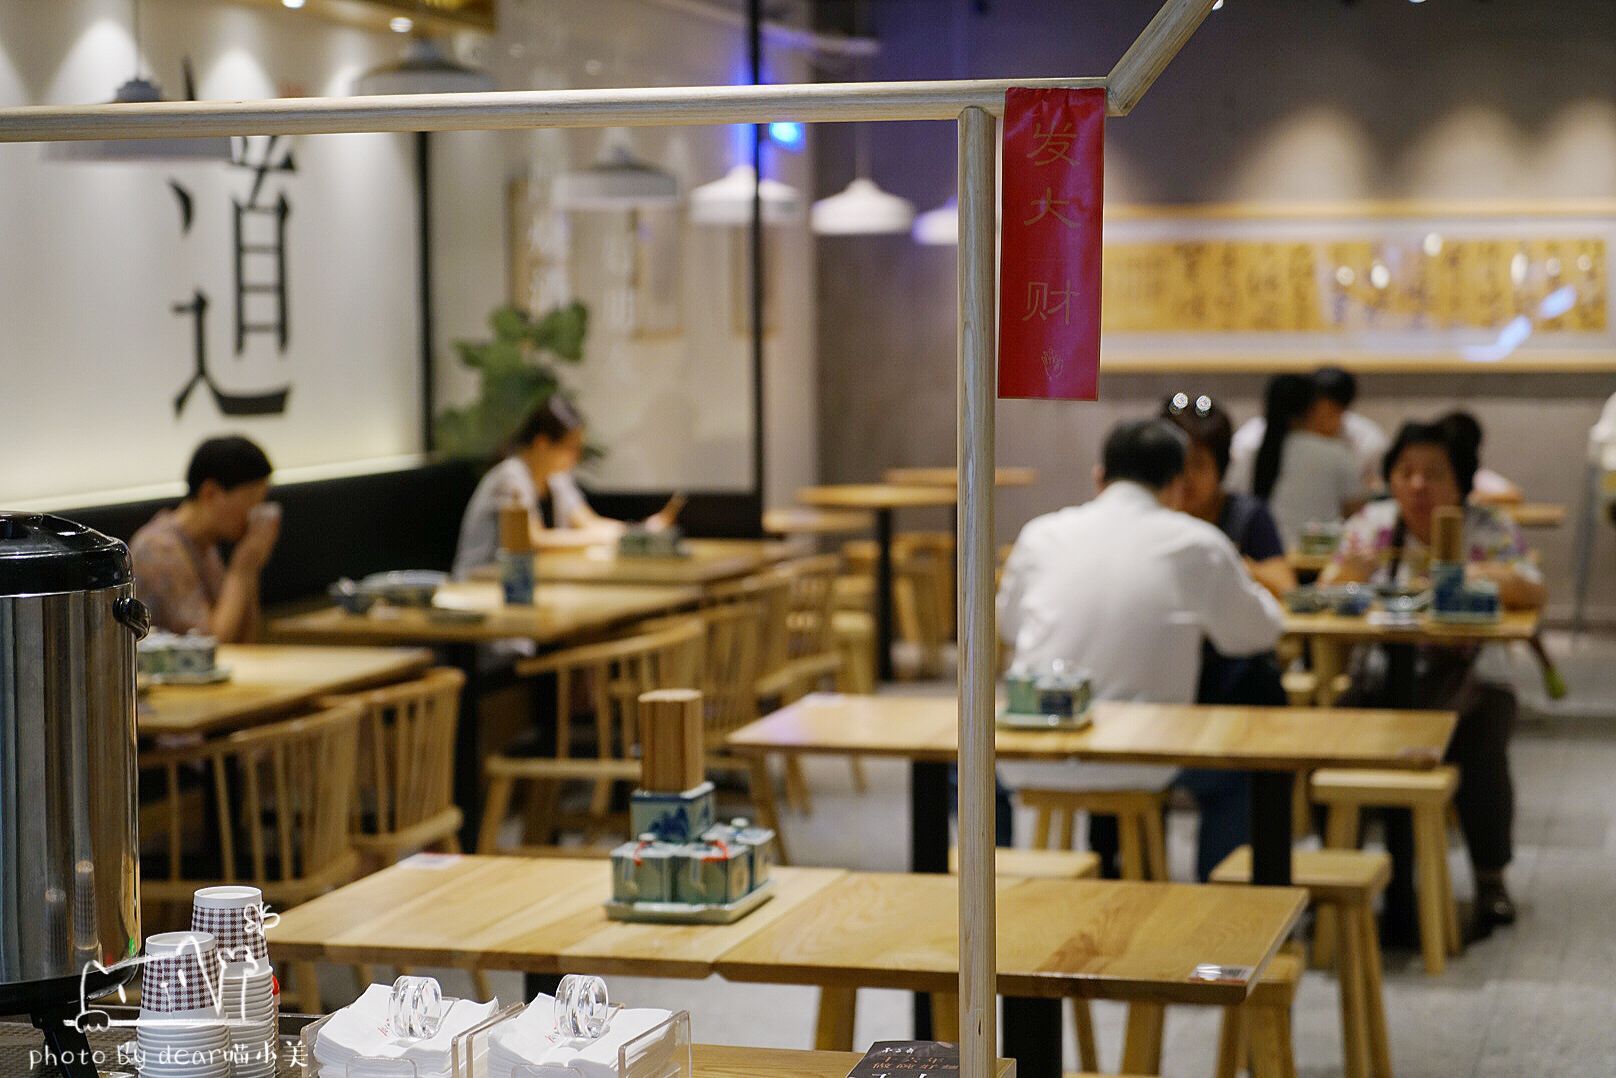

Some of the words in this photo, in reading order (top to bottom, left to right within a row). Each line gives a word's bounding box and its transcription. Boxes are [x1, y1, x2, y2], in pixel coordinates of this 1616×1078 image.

[169, 134, 298, 421] 道
[1021, 121, 1081, 327] 发大财
